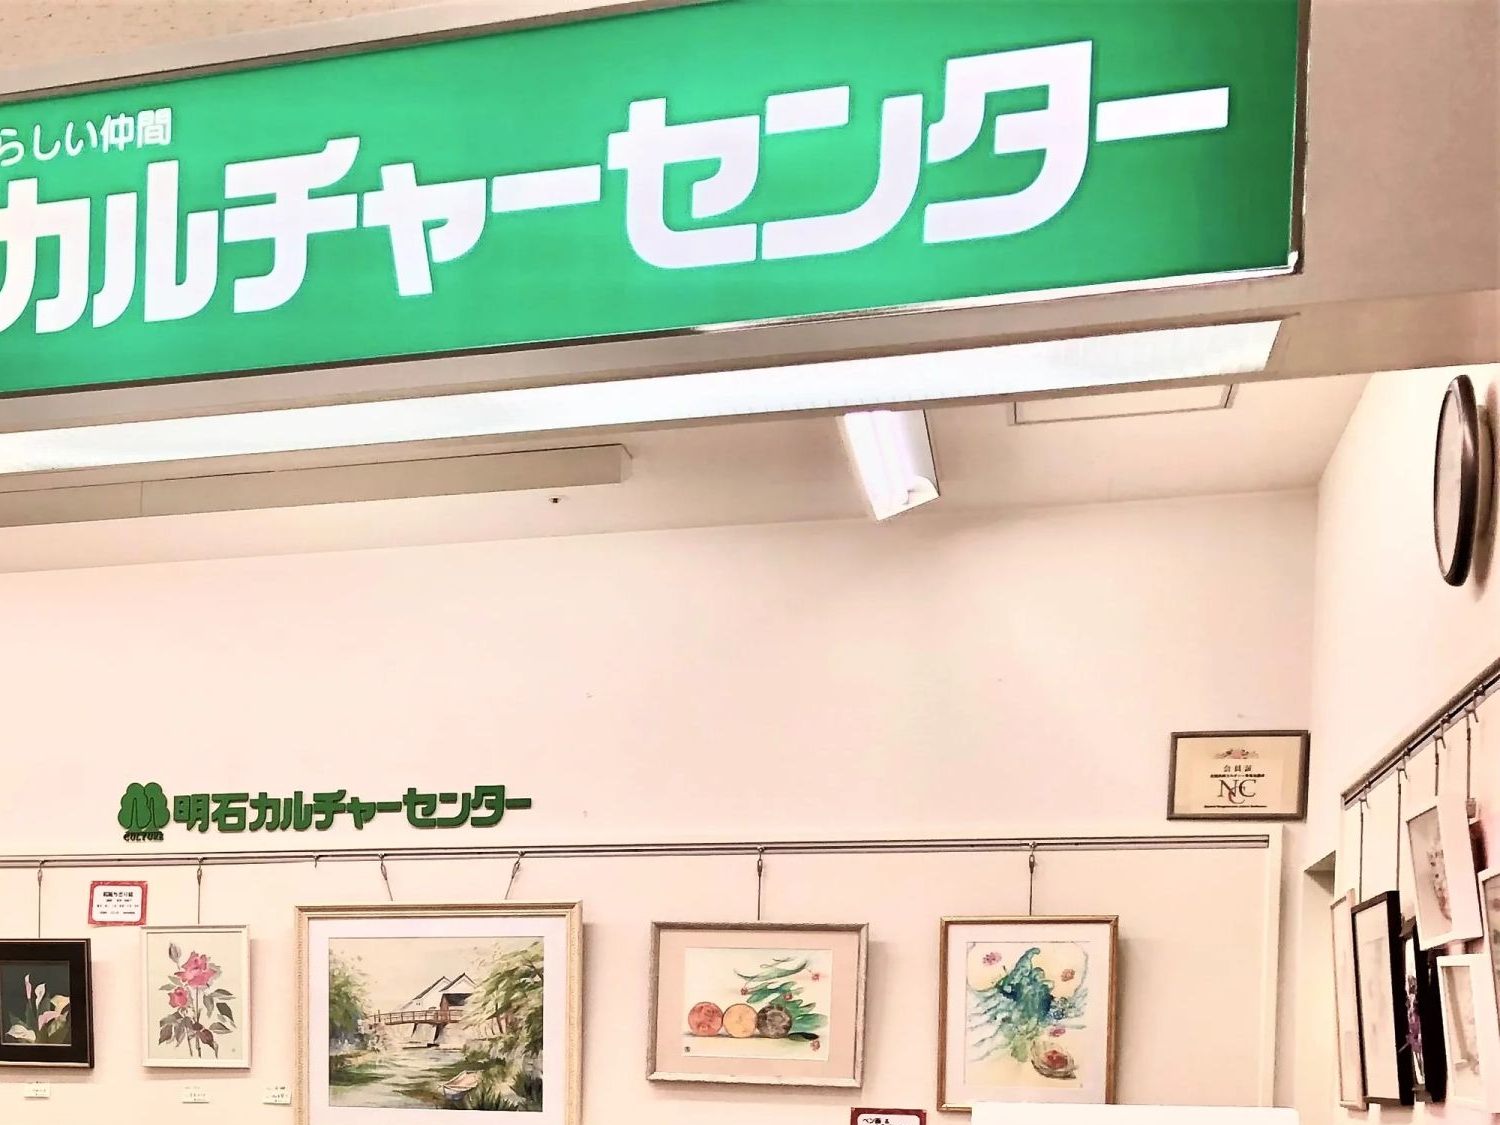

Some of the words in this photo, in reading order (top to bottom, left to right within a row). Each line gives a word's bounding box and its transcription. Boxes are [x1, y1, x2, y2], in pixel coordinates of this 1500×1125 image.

[173, 784, 532, 832] 明石カルチャーセンター
